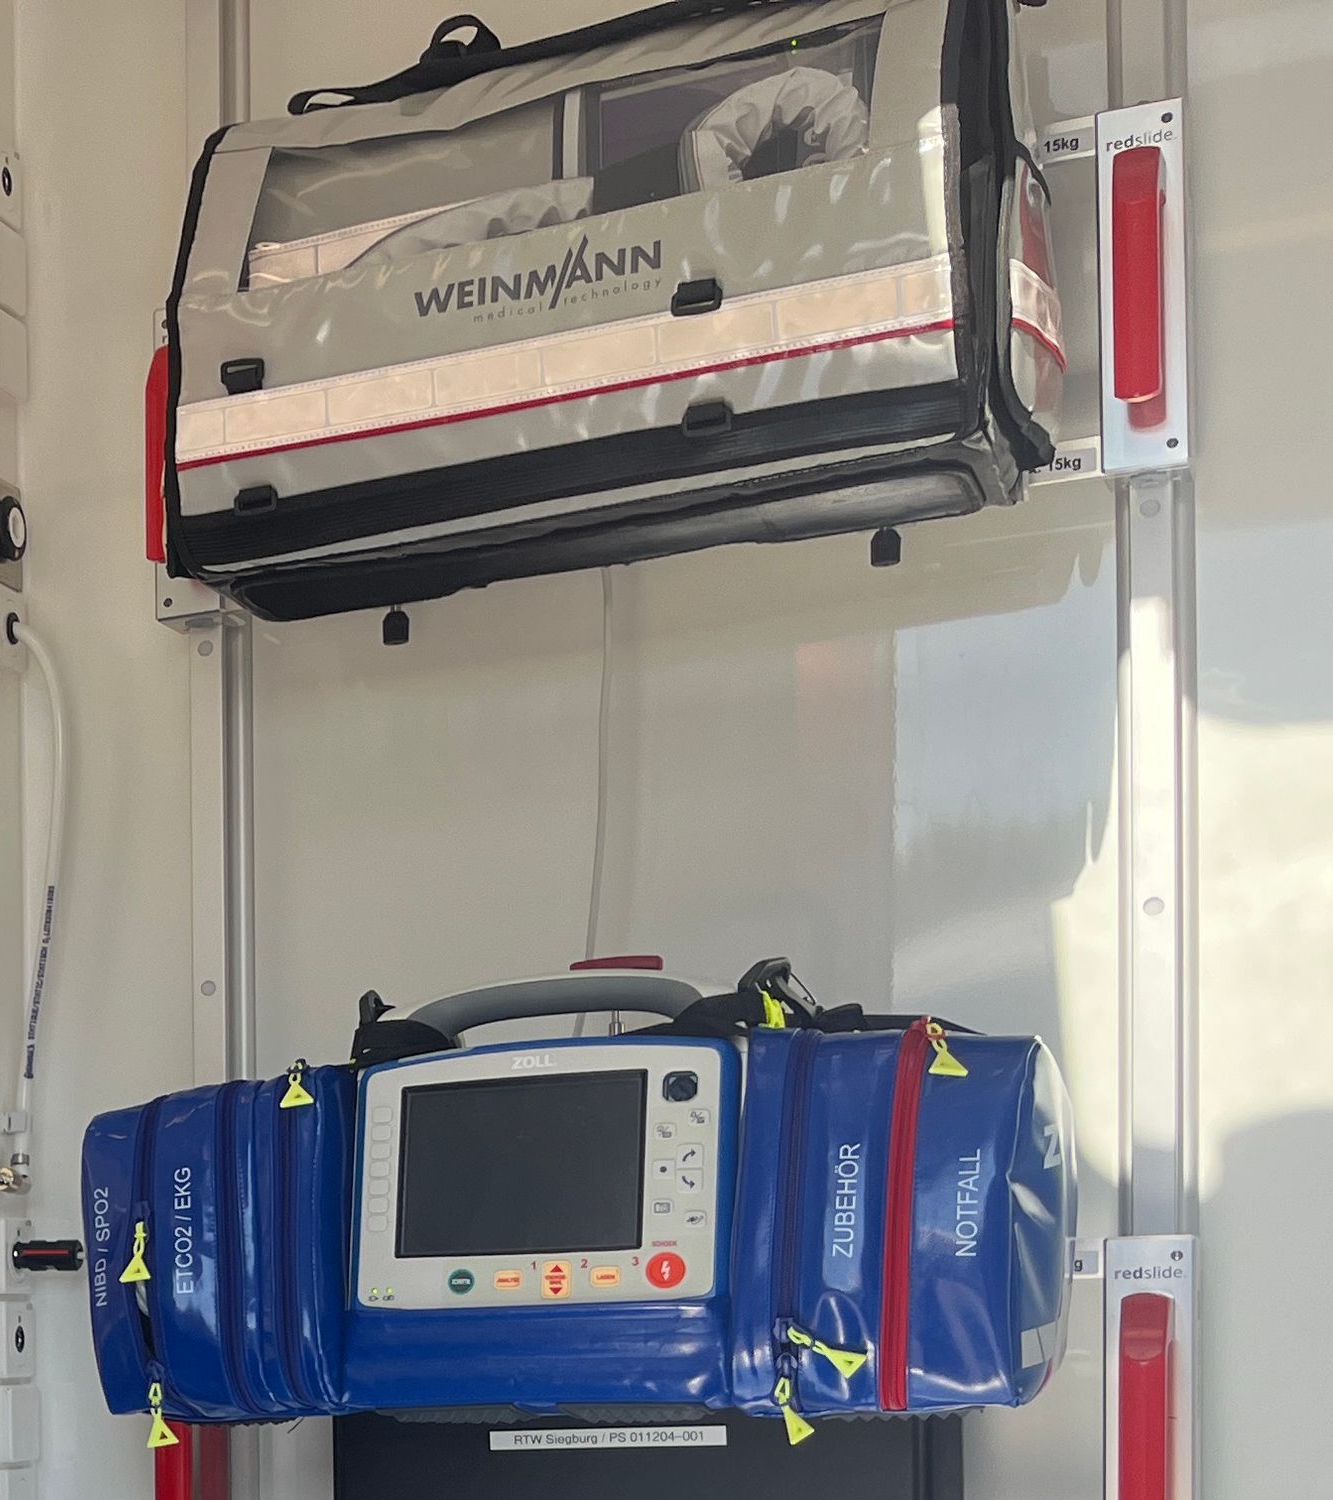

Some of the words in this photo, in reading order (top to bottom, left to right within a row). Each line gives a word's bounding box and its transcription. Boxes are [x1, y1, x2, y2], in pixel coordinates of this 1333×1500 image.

[1043, 137, 1079, 153] 15kg
[1106, 129, 1174, 151] redslide
[414, 234, 661, 317] WEINMANN
[474, 304, 543, 323] medical
[563, 277, 662, 306] technology
[511, 1054, 557, 1070] ZOLL
[174, 1167, 191, 1210] EKG
[832, 1143, 861, 1259] ZUBEHÖR
[955, 1148, 981, 1257] NOTFALL
[94, 1187, 110, 1242] SPO2
[174, 1226, 194, 1294] ETCO2
[531, 1261, 536, 1270] 1
[581, 1259, 588, 1268] 2
[632, 1256, 639, 1266] 3
[1114, 1266, 1183, 1280] redslide
[94, 1257, 108, 1307] NIBD
[514, 1434, 542, 1446] RTW
[546, 1433, 598, 1446] Siegburg
[609, 1432, 626, 1443] PS
[630, 1430, 705, 1443] 011204-001
